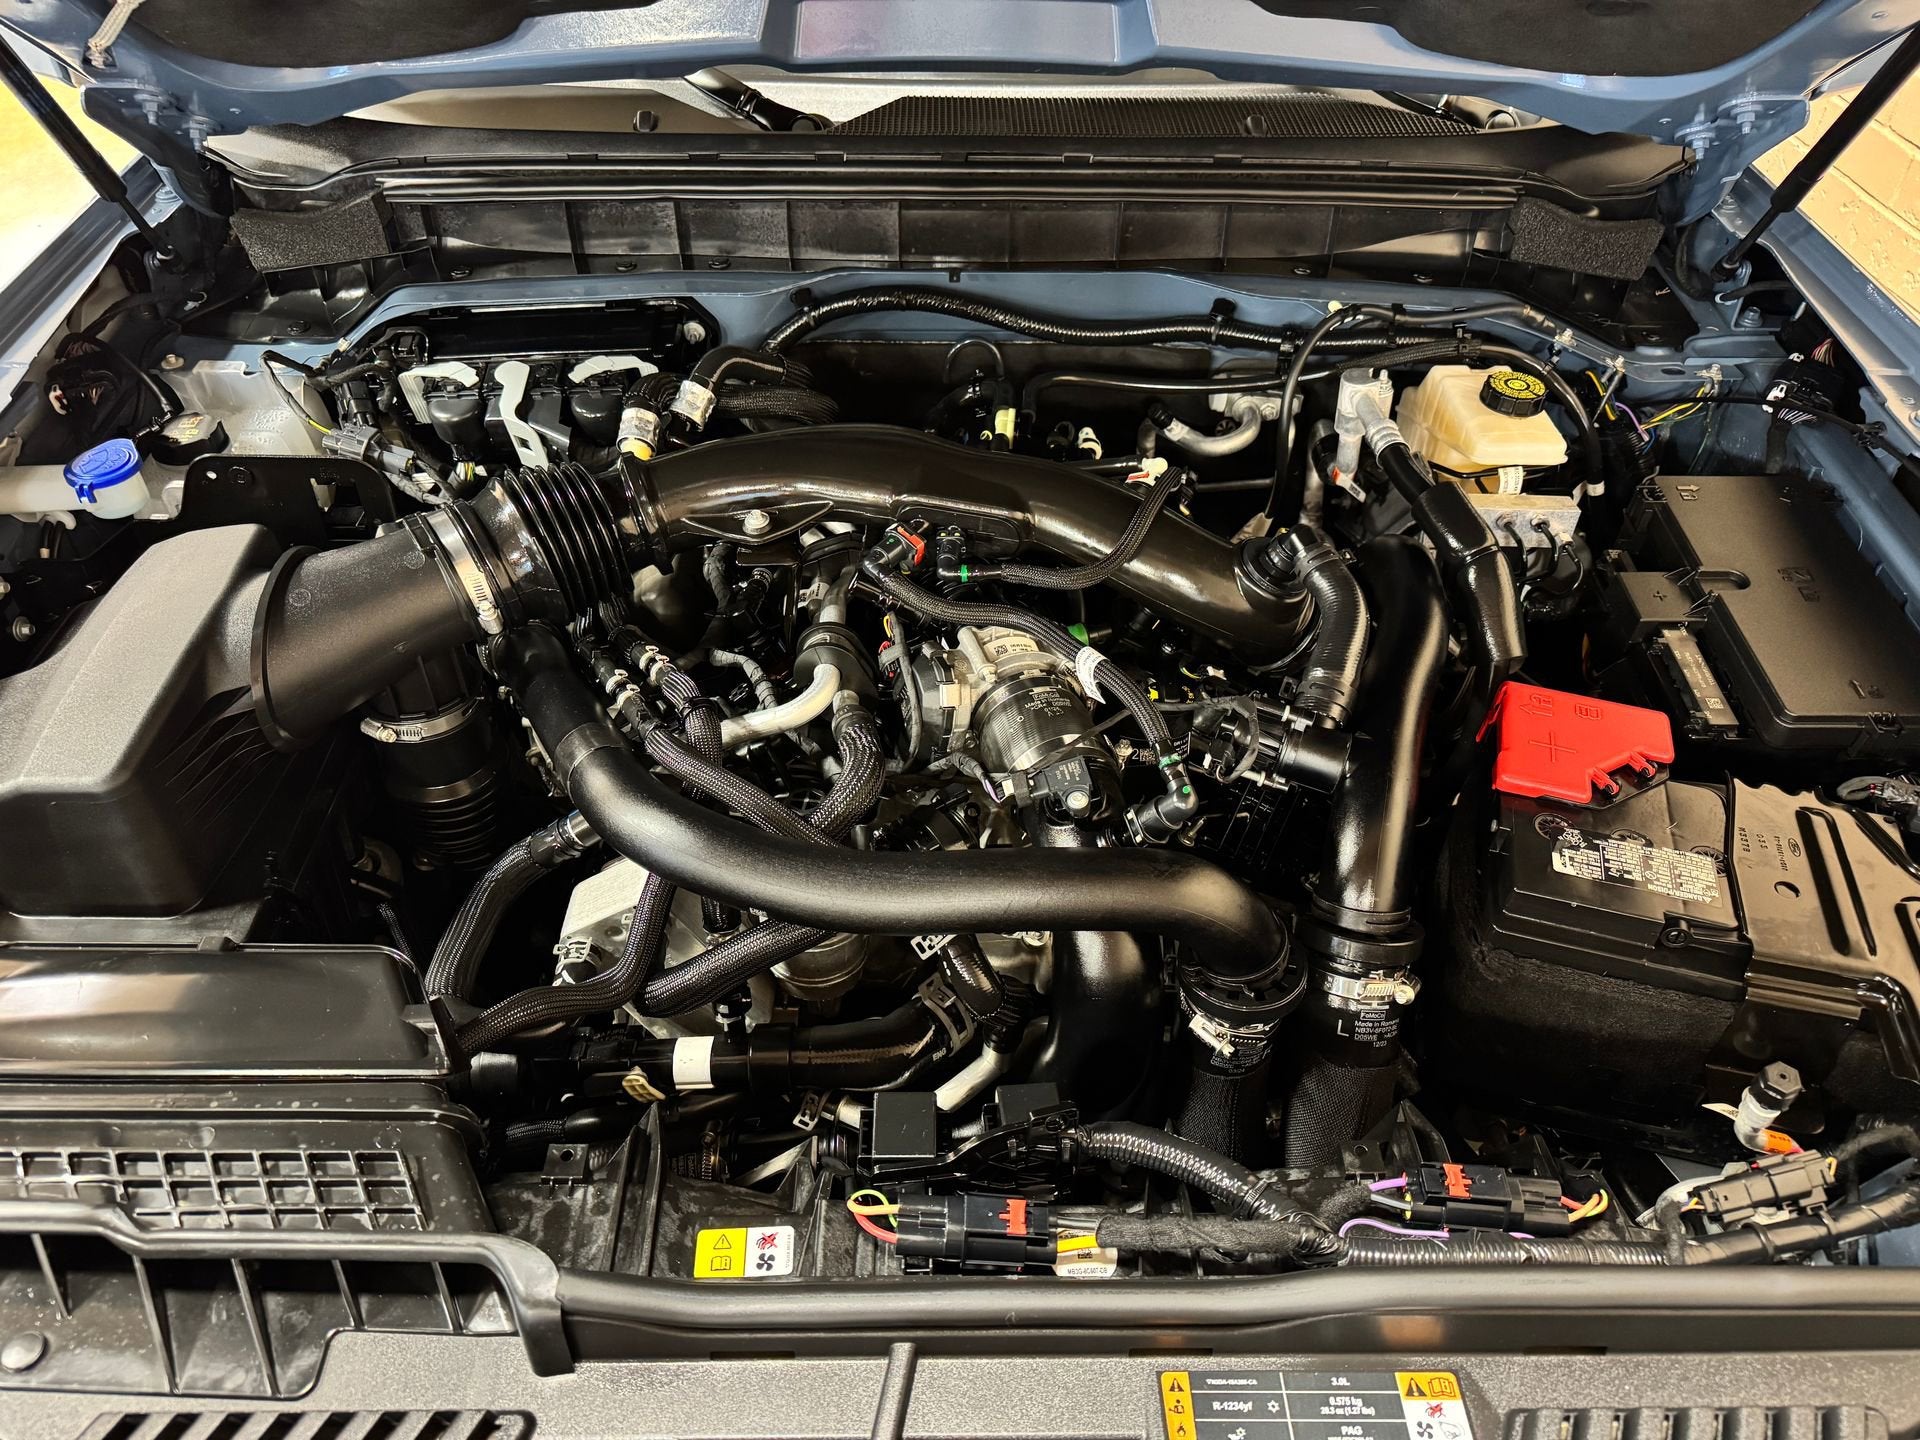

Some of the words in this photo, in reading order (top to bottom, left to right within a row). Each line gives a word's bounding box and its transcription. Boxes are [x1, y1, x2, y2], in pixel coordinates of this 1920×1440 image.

[1337, 1019, 1350, 1037] L
[1331, 1377, 1351, 1386] 3.0L
[1212, 1401, 1253, 1413] R-1234yf
[1351, 1396, 1363, 1408] kg
[1341, 1426, 1363, 1436] PAG
